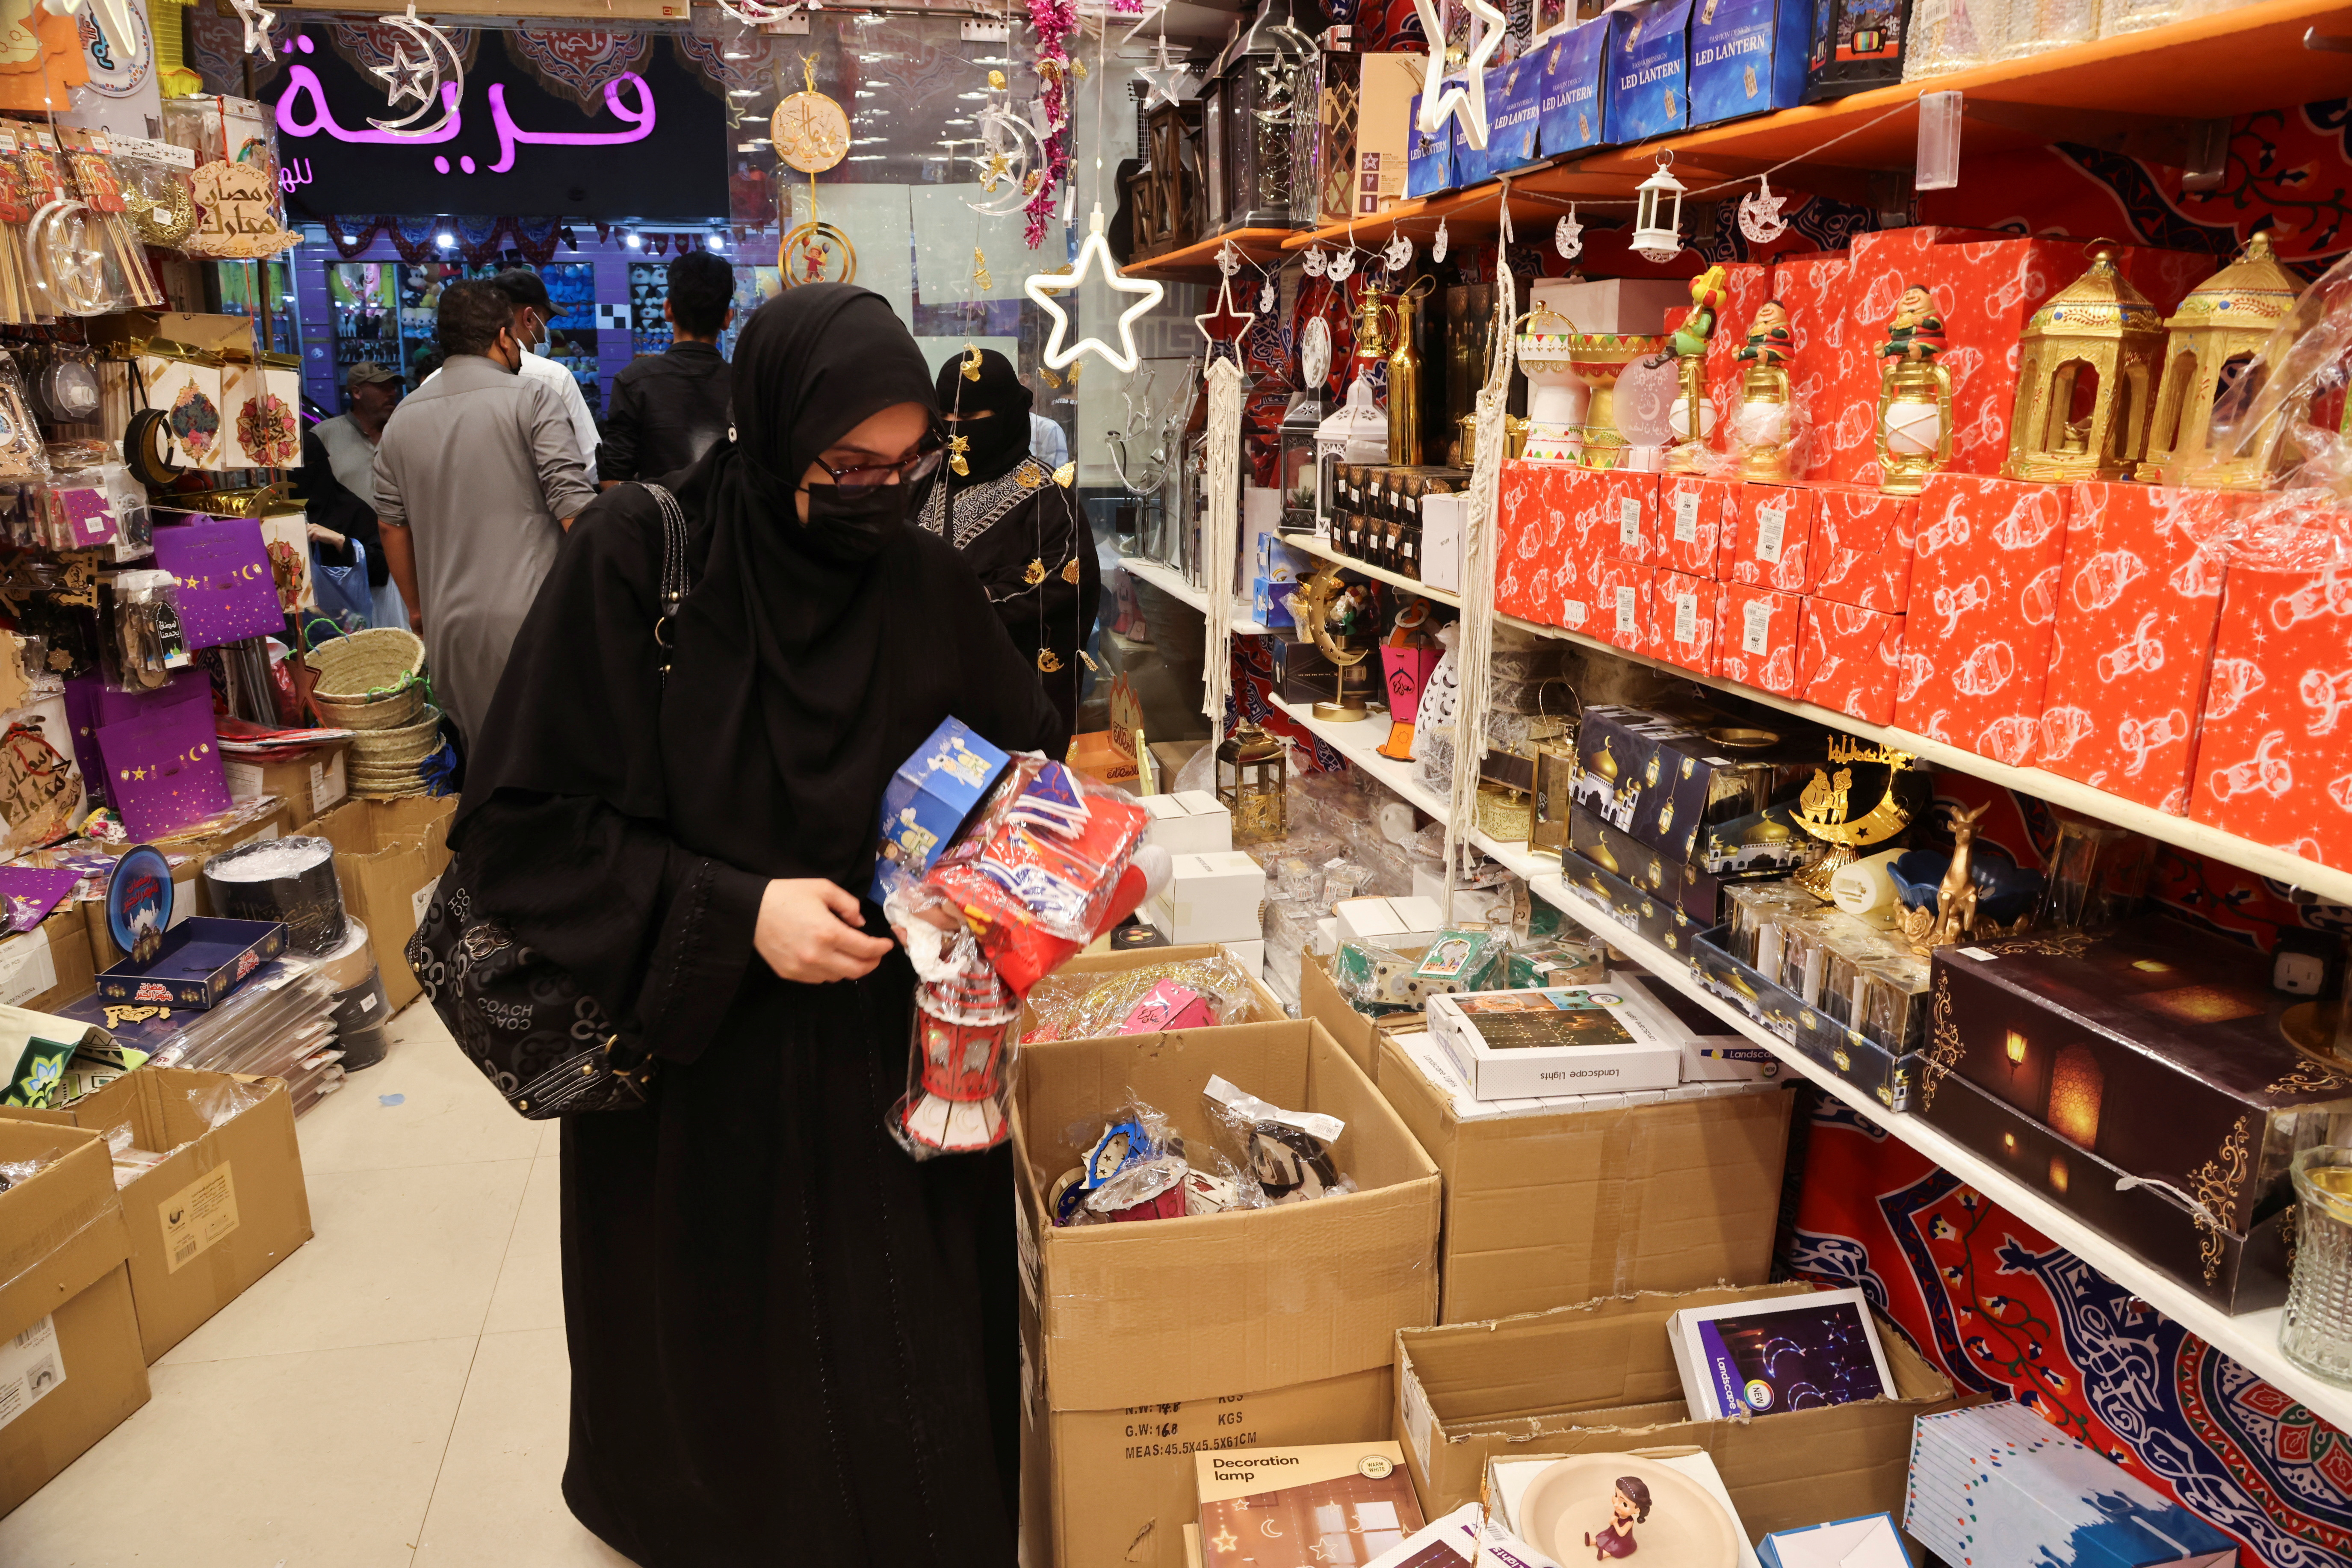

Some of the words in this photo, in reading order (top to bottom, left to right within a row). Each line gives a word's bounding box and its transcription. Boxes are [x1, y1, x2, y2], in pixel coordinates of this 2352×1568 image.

[1709, 31, 1730, 44] FASHION
[1731, 25, 1750, 38] DESIGN
[1695, 49, 1714, 67] LED
[1715, 34, 1765, 60] LANTERN
[1632, 58, 1651, 69] FASHION
[1652, 52, 1667, 63] DESIGN
[1621, 74, 1637, 90] LED
[1640, 59, 1680, 85] LANTERN
[1552, 82, 1567, 92] FASHION
[1567, 77, 1582, 87] DESIGN
[1506, 101, 1520, 111] FASHION
[1520, 96, 1534, 106] DESIGN
[1542, 96, 1556, 112] LED
[1557, 85, 1593, 108] LANTERN
[1494, 117, 1508, 130] LED
[1509, 105, 1539, 125] LANTERN
[1457, 133, 1468, 146] LED
[1411, 149, 1421, 161] LED
[1422, 139, 1447, 157] LANTERN
[477, 997, 533, 1017] COACH
[1625, 1011, 1638, 1021] Lights
[1636, 1021, 1658, 1042] Landscape
[1730, 1050, 1775, 1058] Landscap
[1423, 1054, 1446, 1076] Landscape
[1443, 1075, 1458, 1088] Lights
[1540, 1071, 1566, 1080] Lights
[1569, 1069, 1619, 1078] Landscape
[1717, 1357, 1737, 1410] Landscape
[1752, 1387, 1764, 1404] NEW
[1125, 1423, 1152, 1437] G.W:
[1218, 1411, 1243, 1426] KGS
[1213, 1456, 1300, 1468] Decoration
[1215, 1471, 1255, 1482] lamp
